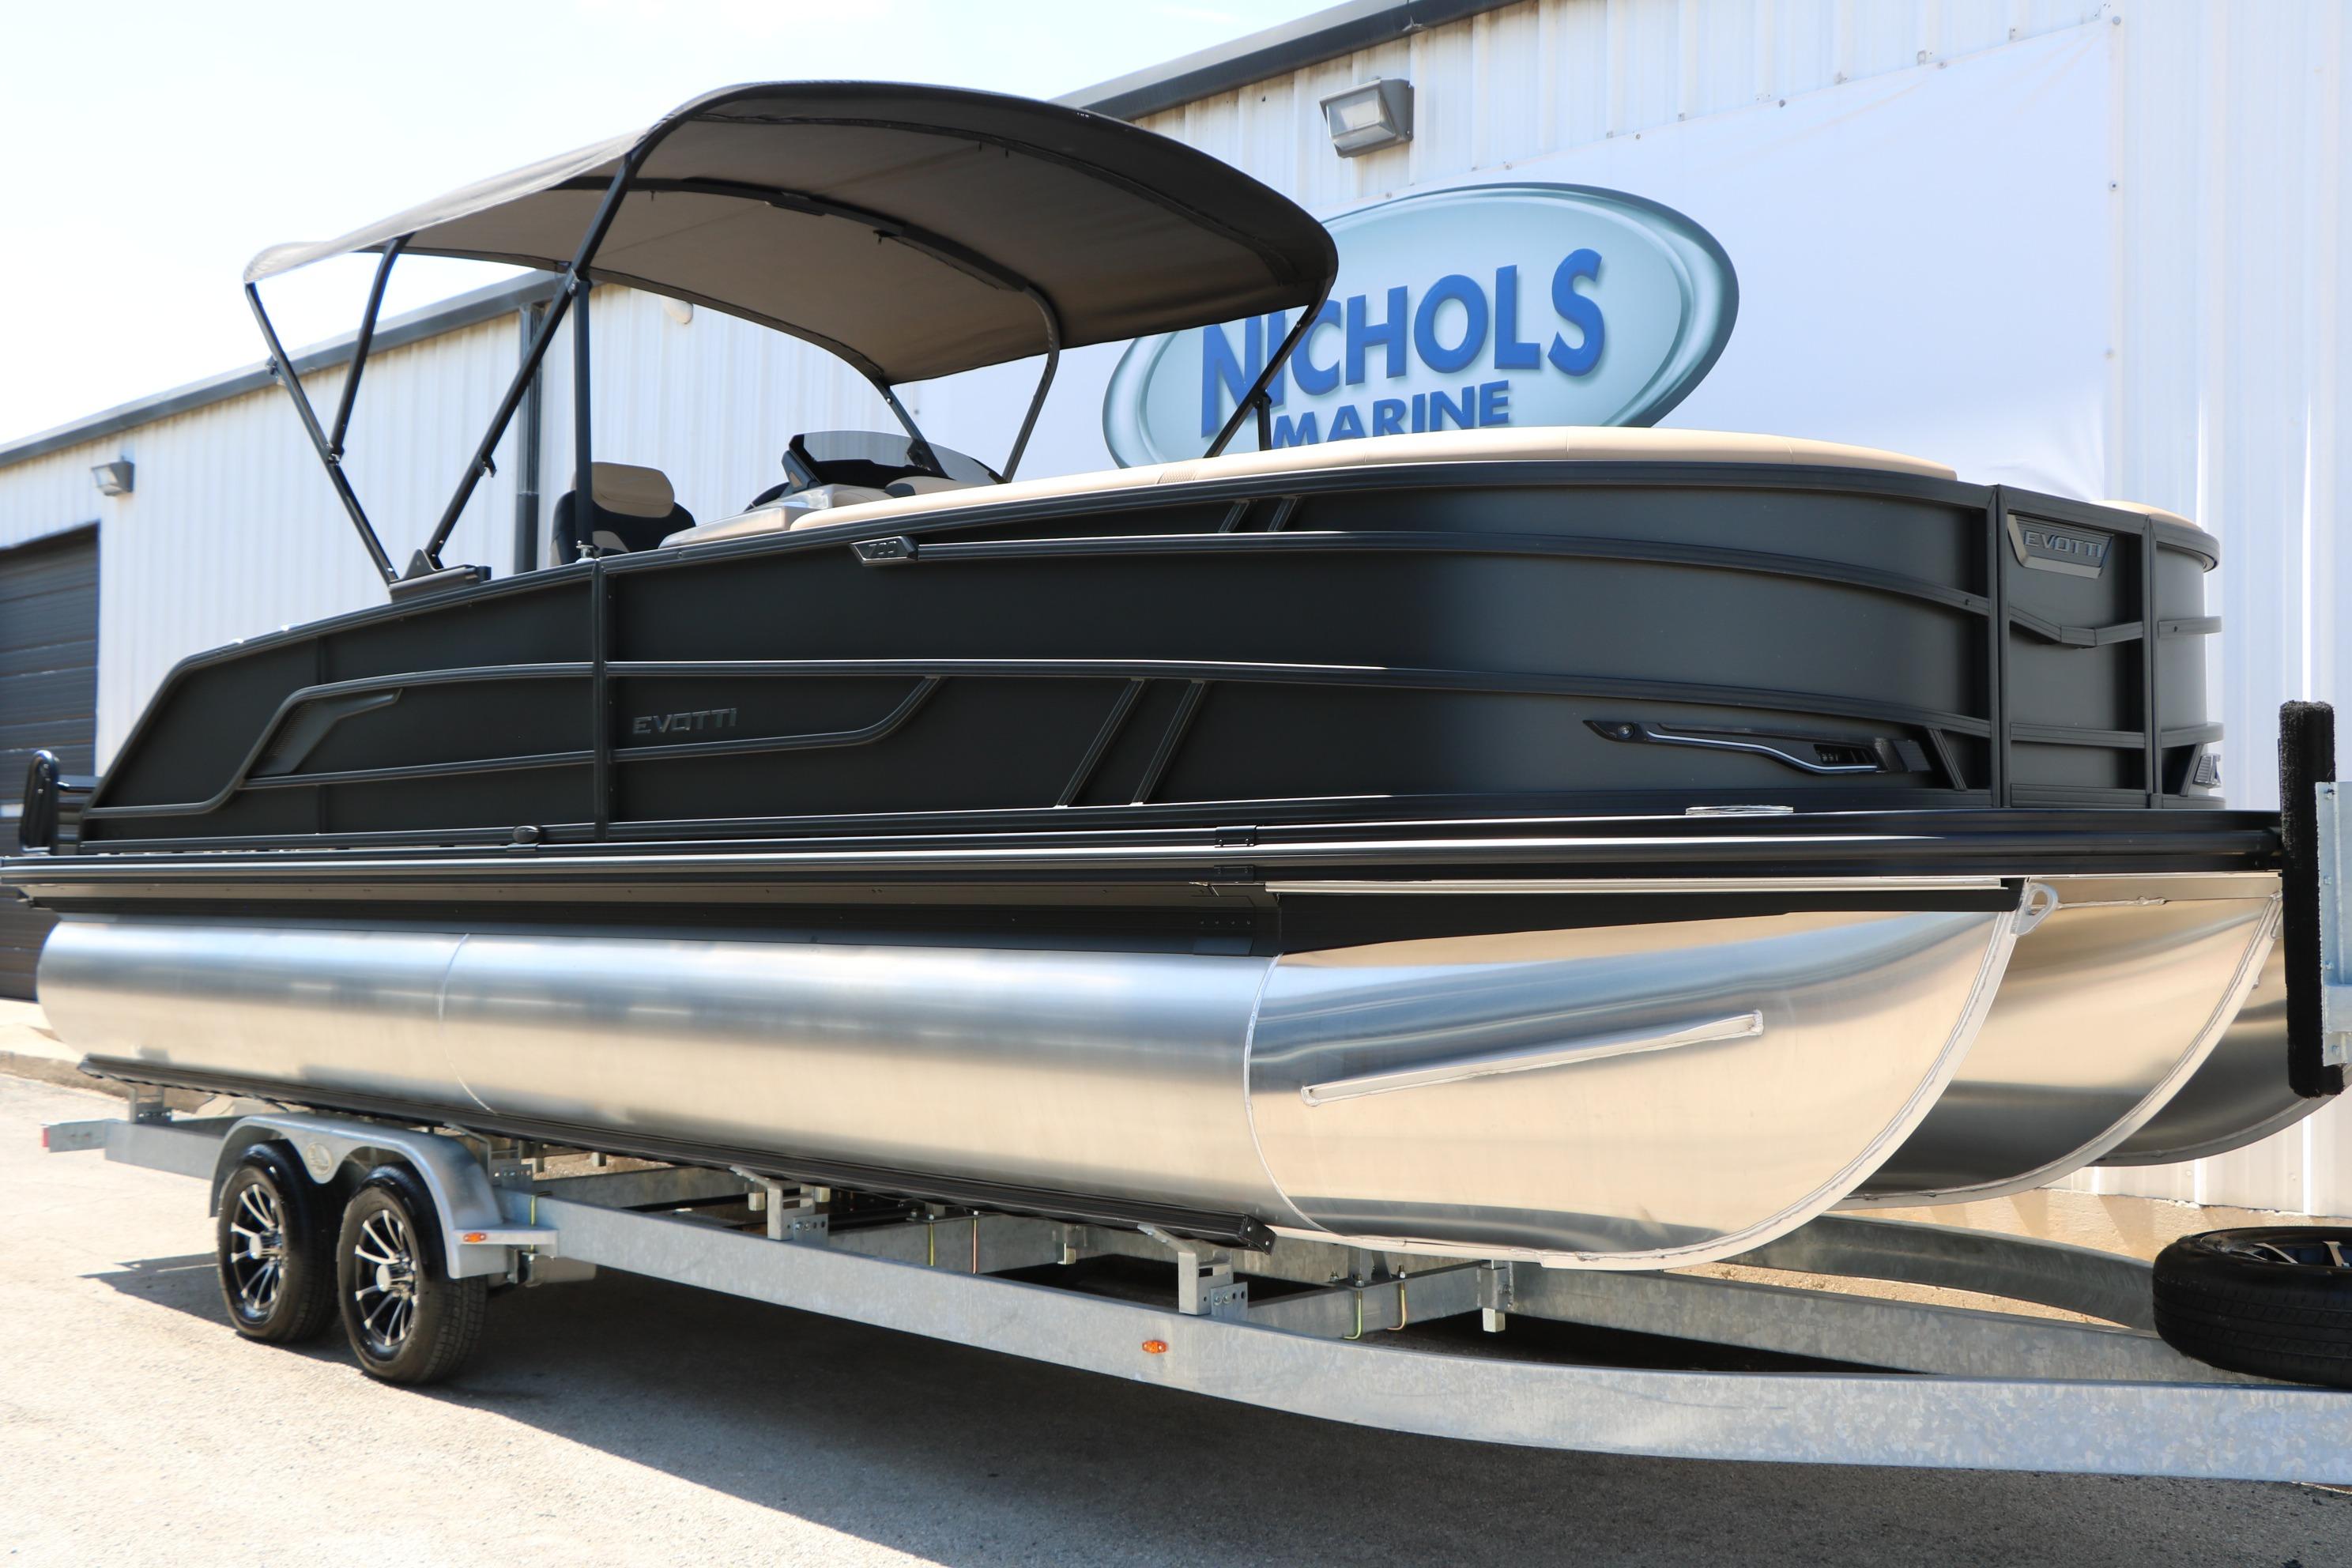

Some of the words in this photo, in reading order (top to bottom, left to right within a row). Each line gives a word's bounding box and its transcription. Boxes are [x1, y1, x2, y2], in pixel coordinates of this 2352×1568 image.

[1200, 248, 1605, 439] NICHOLS
[1271, 379, 1510, 450] MARINE
[2023, 530, 2102, 557] EVOTTI
[632, 708, 737, 733] EVOTTI
